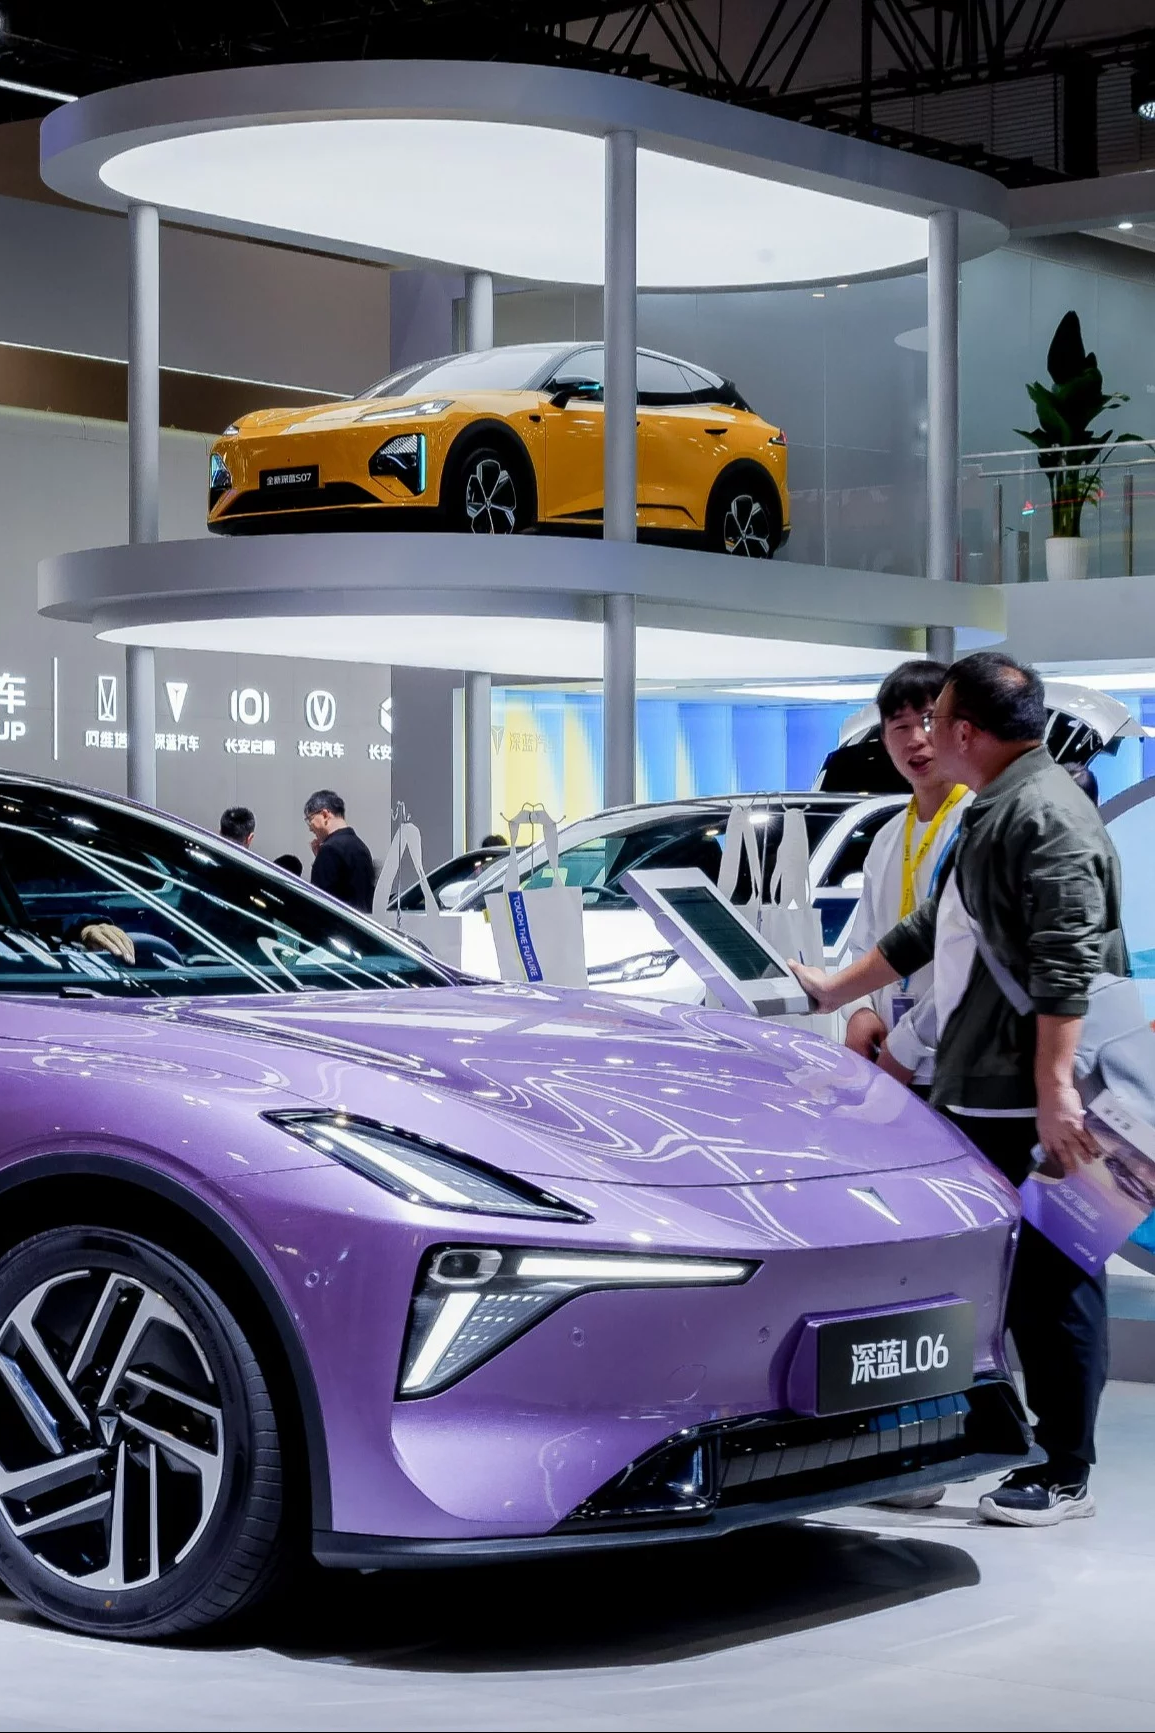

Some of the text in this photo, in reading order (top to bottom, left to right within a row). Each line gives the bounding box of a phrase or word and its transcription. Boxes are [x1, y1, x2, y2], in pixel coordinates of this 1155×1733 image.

[298, 740, 344, 758] 长安汽车
[509, 731, 553, 753] 深蓝汽
[513, 895, 539, 977] TOUCH THE FUTURE
[850, 1333, 949, 1385] 深蓝L06
